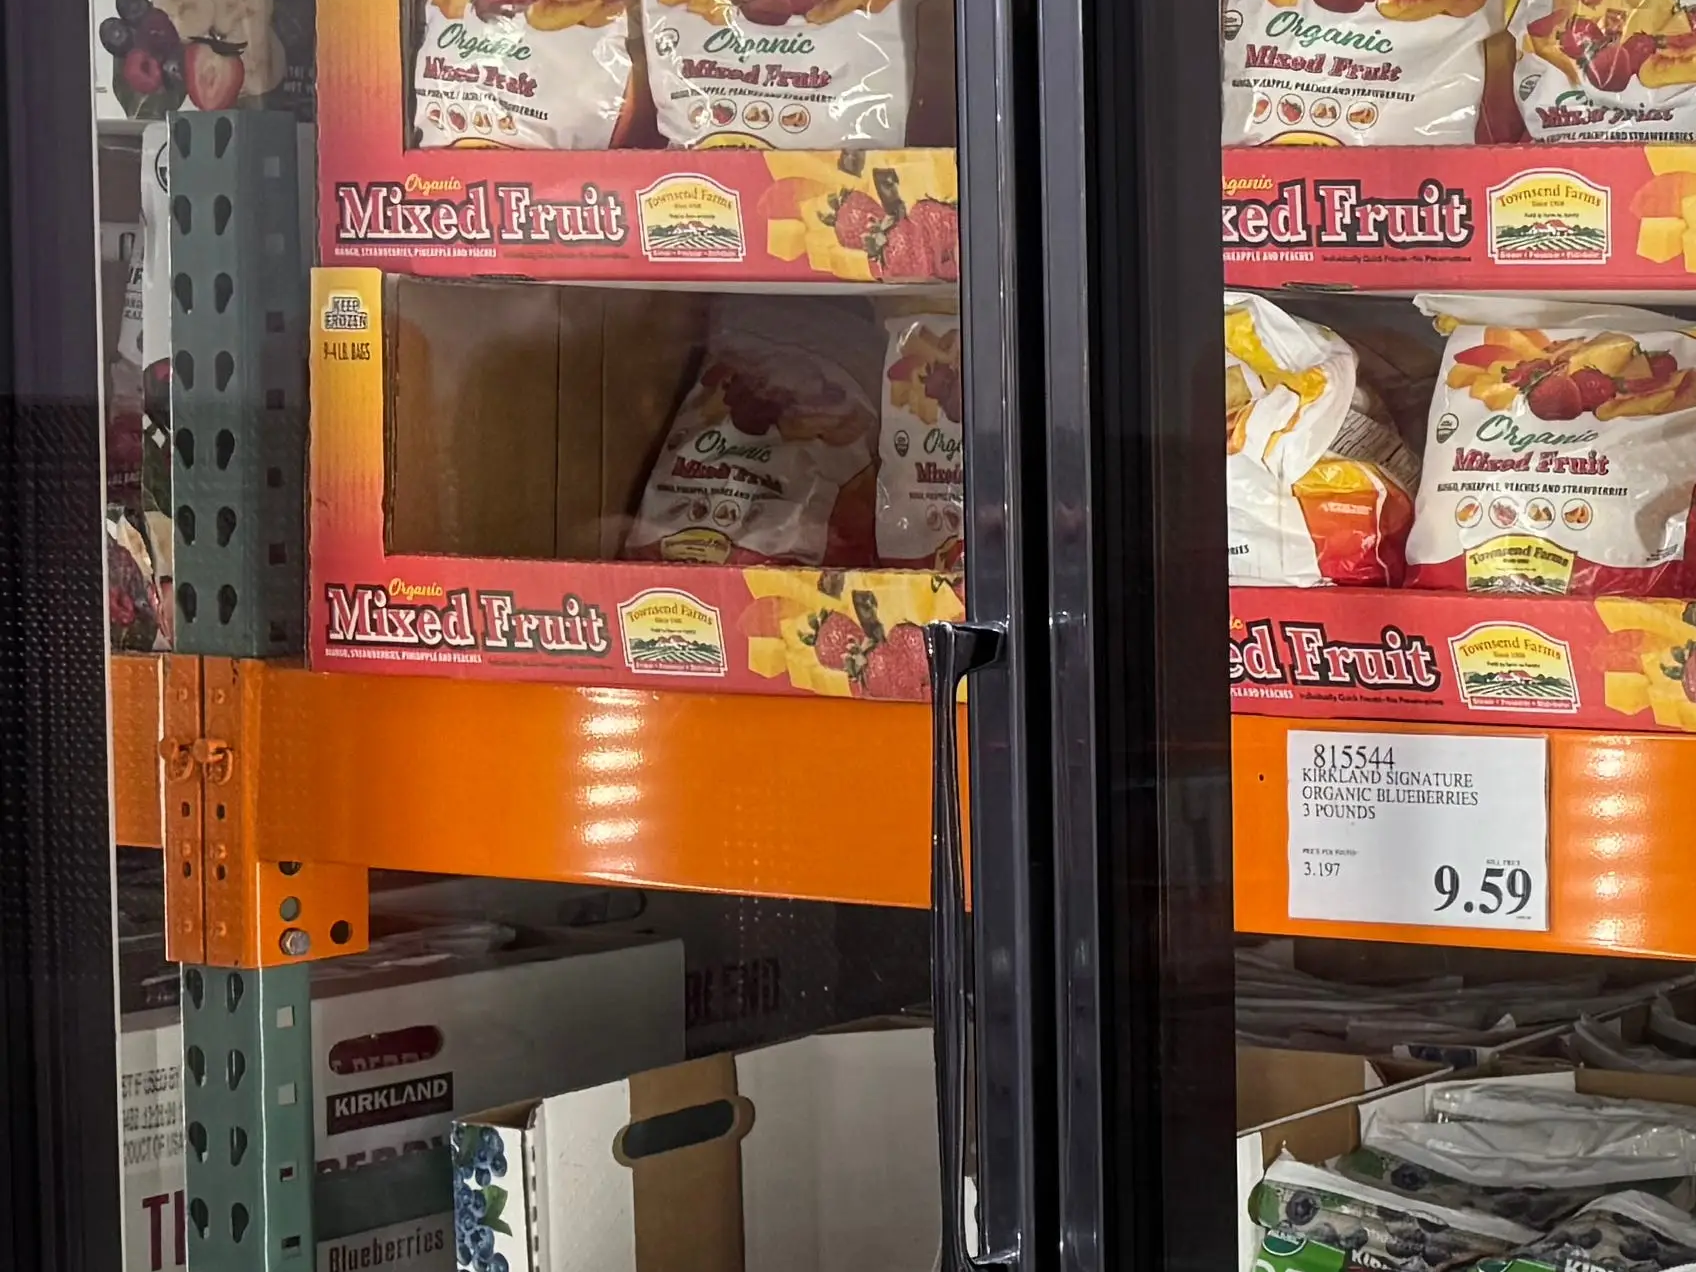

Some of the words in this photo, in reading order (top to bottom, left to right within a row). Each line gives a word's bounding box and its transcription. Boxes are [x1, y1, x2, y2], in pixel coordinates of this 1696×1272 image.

[339, 184, 489, 242] Mixed
[499, 184, 625, 244] Fruit
[1318, 179, 1474, 246] Fruit
[1477, 415, 1599, 453] Organic
[1452, 448, 1530, 474] Mixed
[1535, 451, 1610, 477] Fruit
[328, 585, 472, 651] Mixed
[482, 589, 608, 655] Fruit
[1292, 625, 1441, 691] Fruit
[1459, 637, 1519, 657] Townsend
[1524, 639, 1560, 660] Farms
[1314, 744, 1395, 769] 815544
[1303, 768, 1381, 785] KIRKLAND
[1386, 771, 1473, 787] SIGNATURE
[1303, 787, 1371, 802] ORGANIC
[1377, 790, 1478, 805] BLUEBERRIES
[1303, 804, 1309, 817] 3
[1316, 805, 1375, 819] POUNDS
[1304, 862, 1340, 876] 3.197
[1434, 865, 1532, 915] 9.59
[335, 1077, 448, 1118] KIRKLAND
